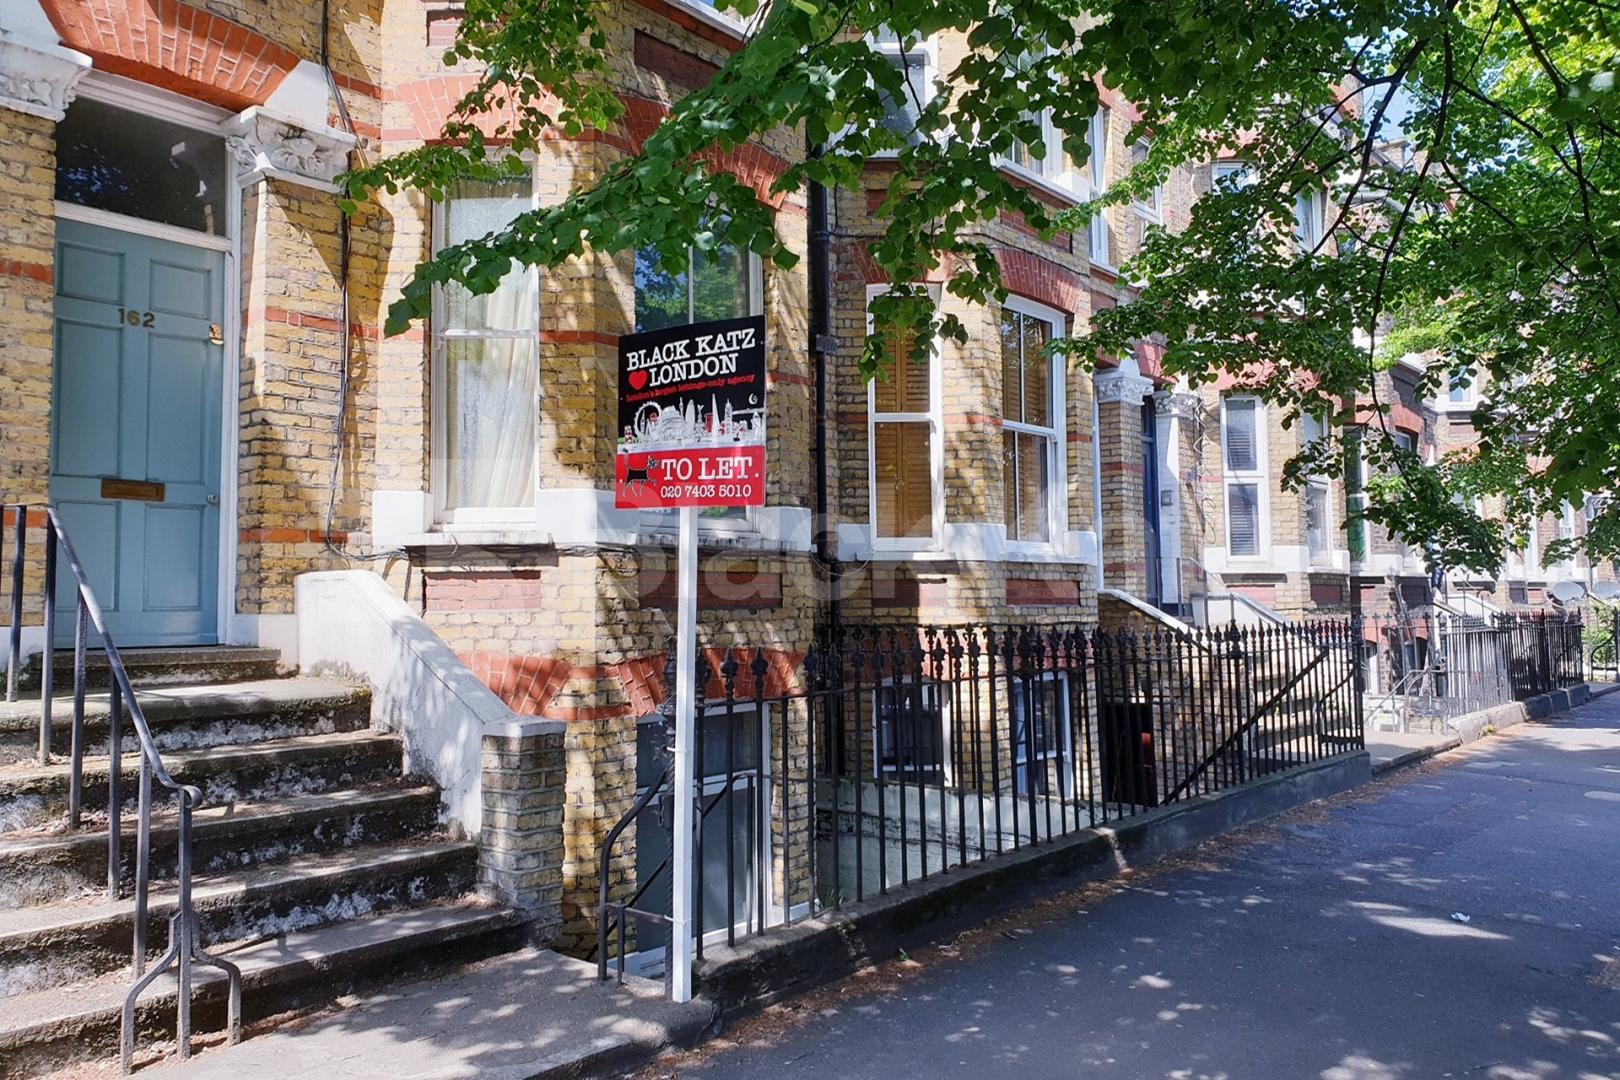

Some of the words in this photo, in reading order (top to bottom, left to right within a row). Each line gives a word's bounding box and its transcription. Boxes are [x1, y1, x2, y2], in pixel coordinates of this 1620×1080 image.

[117, 308, 156, 328] 162
[626, 339, 690, 371] BLACK
[695, 328, 756, 357] KATZ
[649, 353, 739, 387] LONDON
[727, 373, 755, 386] agency
[660, 457, 693, 481] TO
[660, 485, 682, 498] 020
[685, 484, 715, 498] 7403
[719, 484, 752, 497] 5010
